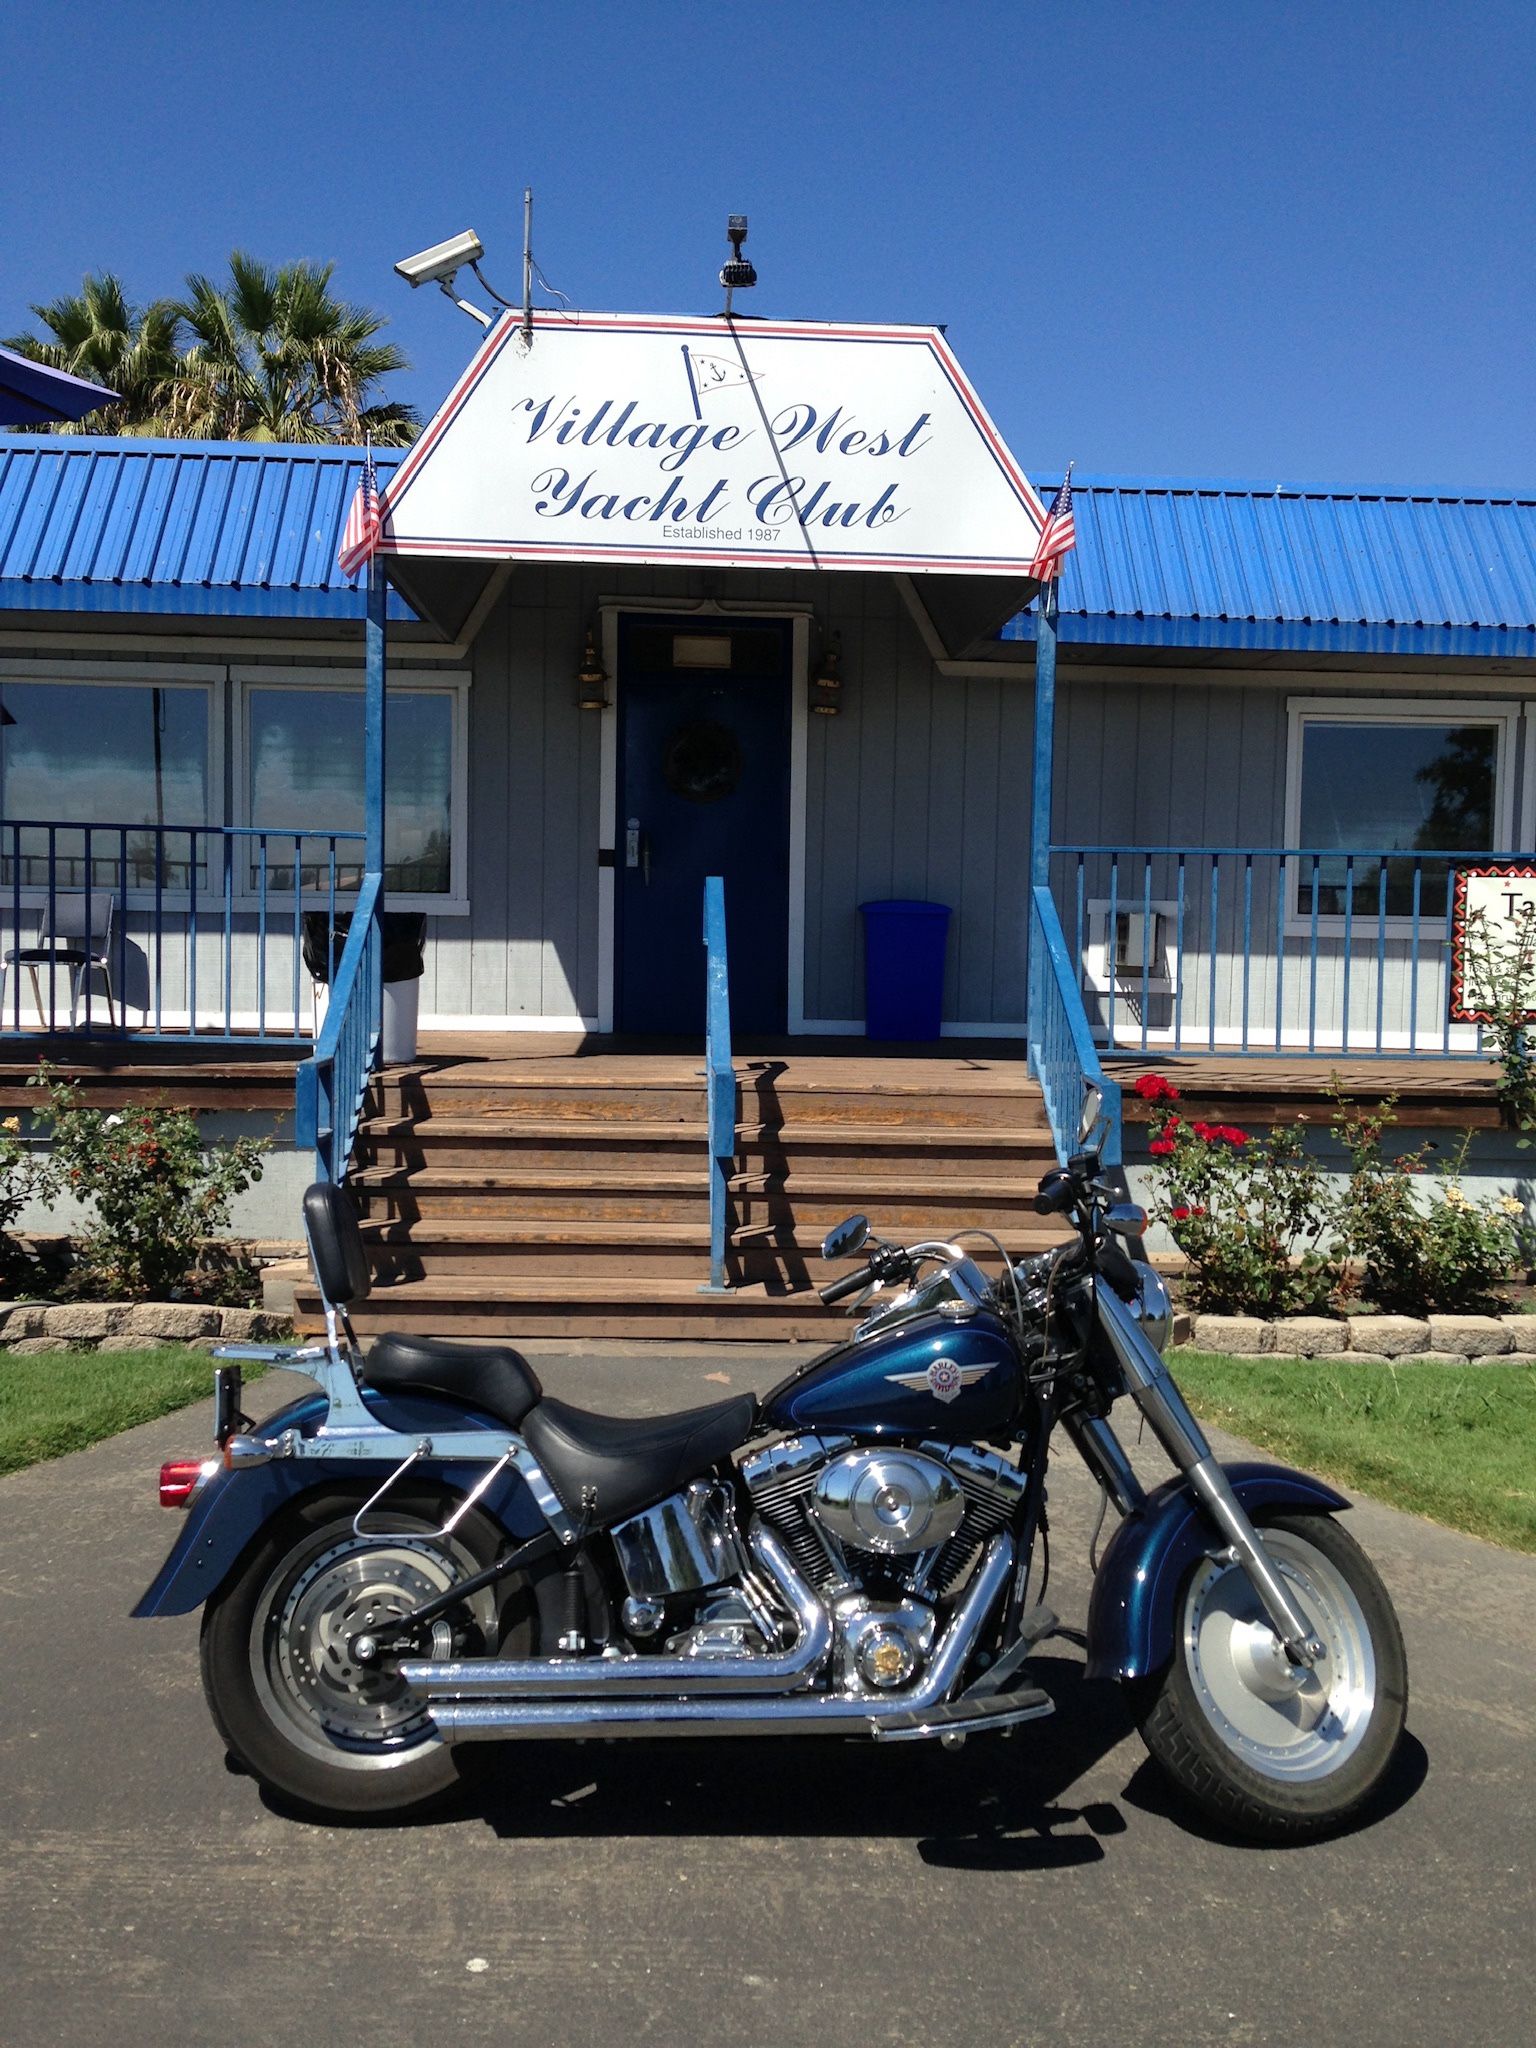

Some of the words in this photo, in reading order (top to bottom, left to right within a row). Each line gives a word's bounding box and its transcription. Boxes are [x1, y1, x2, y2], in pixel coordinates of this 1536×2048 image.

[511, 395, 757, 471] Village
[771, 404, 933, 457] West
[531, 467, 732, 523] Yacht
[747, 475, 911, 528] Club
[663, 525, 742, 540] Established
[748, 528, 781, 541] 1987
